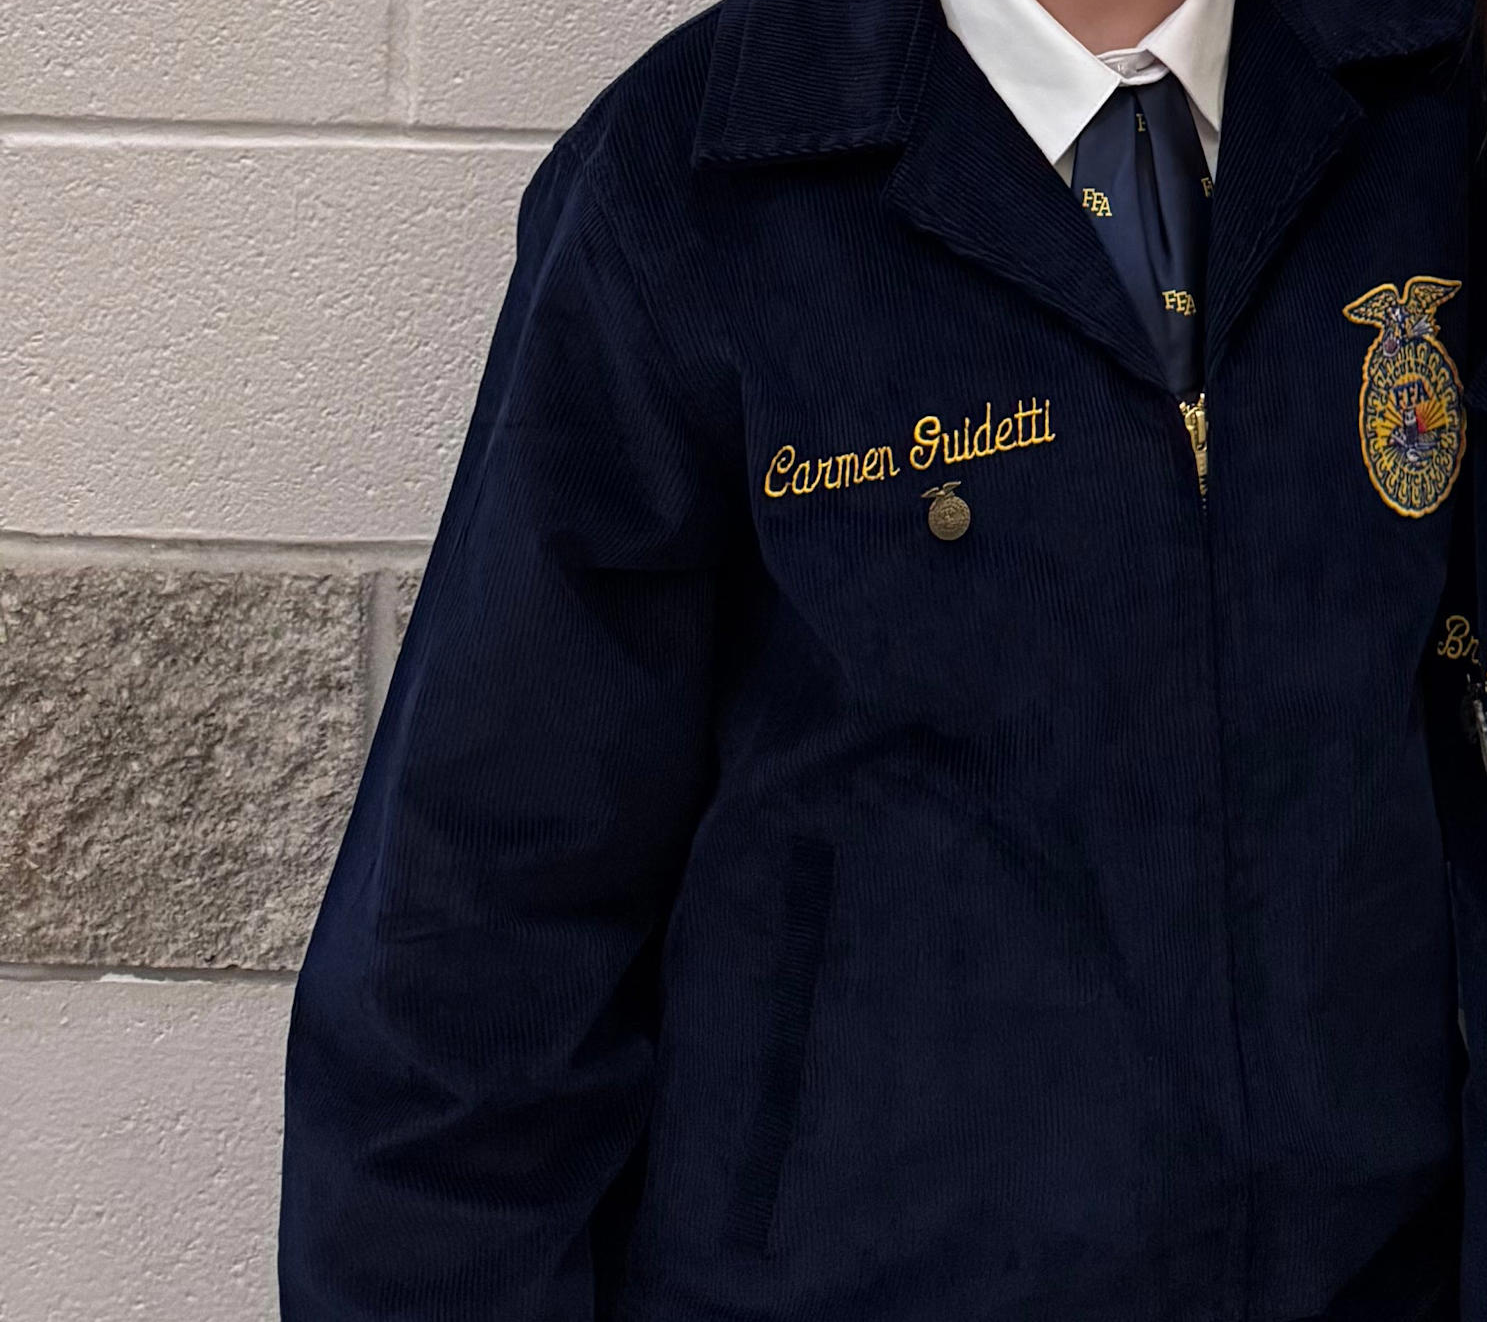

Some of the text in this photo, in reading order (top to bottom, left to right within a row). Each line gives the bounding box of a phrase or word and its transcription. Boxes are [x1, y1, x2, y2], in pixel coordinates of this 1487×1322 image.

[1082, 187, 1112, 217] FFA
[1162, 289, 1197, 317] FFA
[1392, 379, 1432, 410] FFA
[764, 396, 1056, 499] Carmen Guidetti
